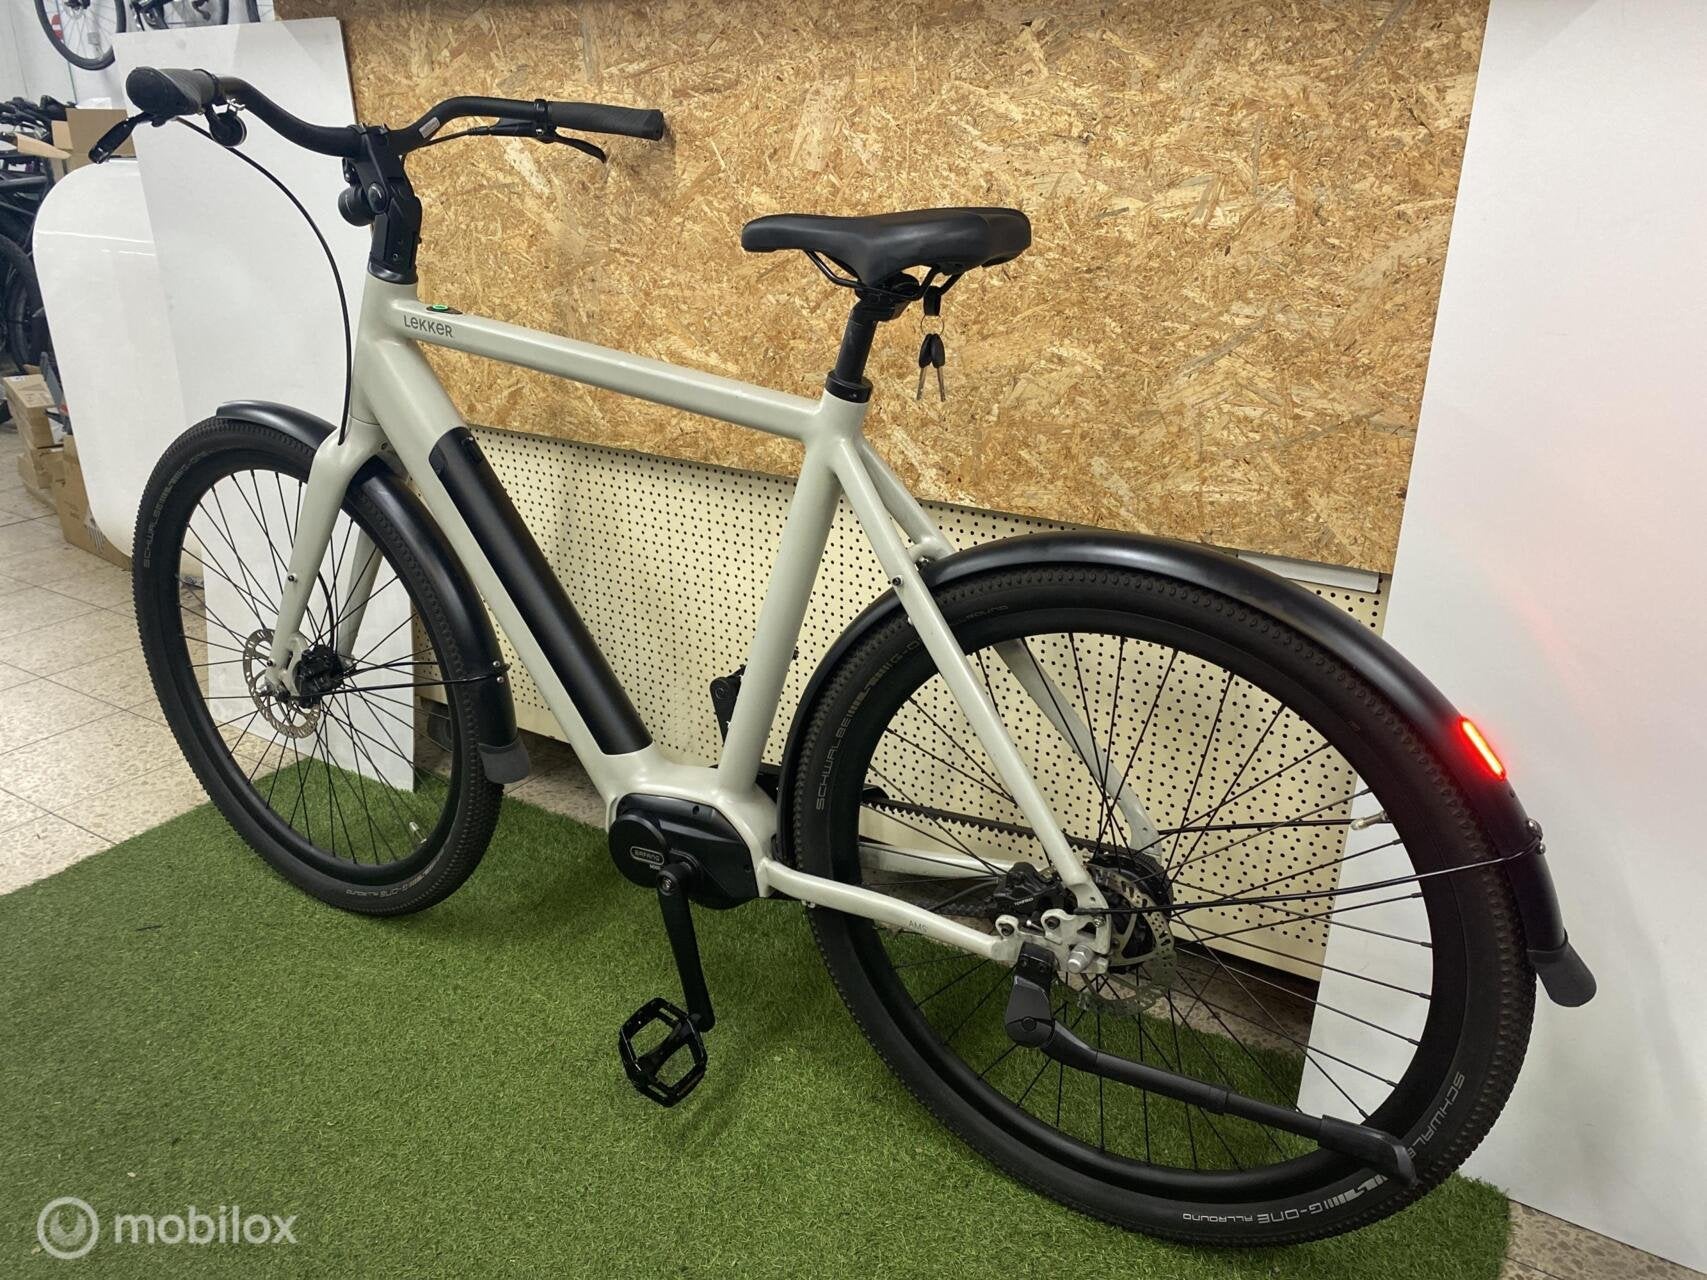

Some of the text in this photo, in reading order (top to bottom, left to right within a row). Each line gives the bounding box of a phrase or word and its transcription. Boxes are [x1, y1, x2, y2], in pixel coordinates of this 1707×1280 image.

[815, 717, 852, 810] SCHWALBE
[1183, 1203, 1324, 1224] G-ONE ALLROUND
